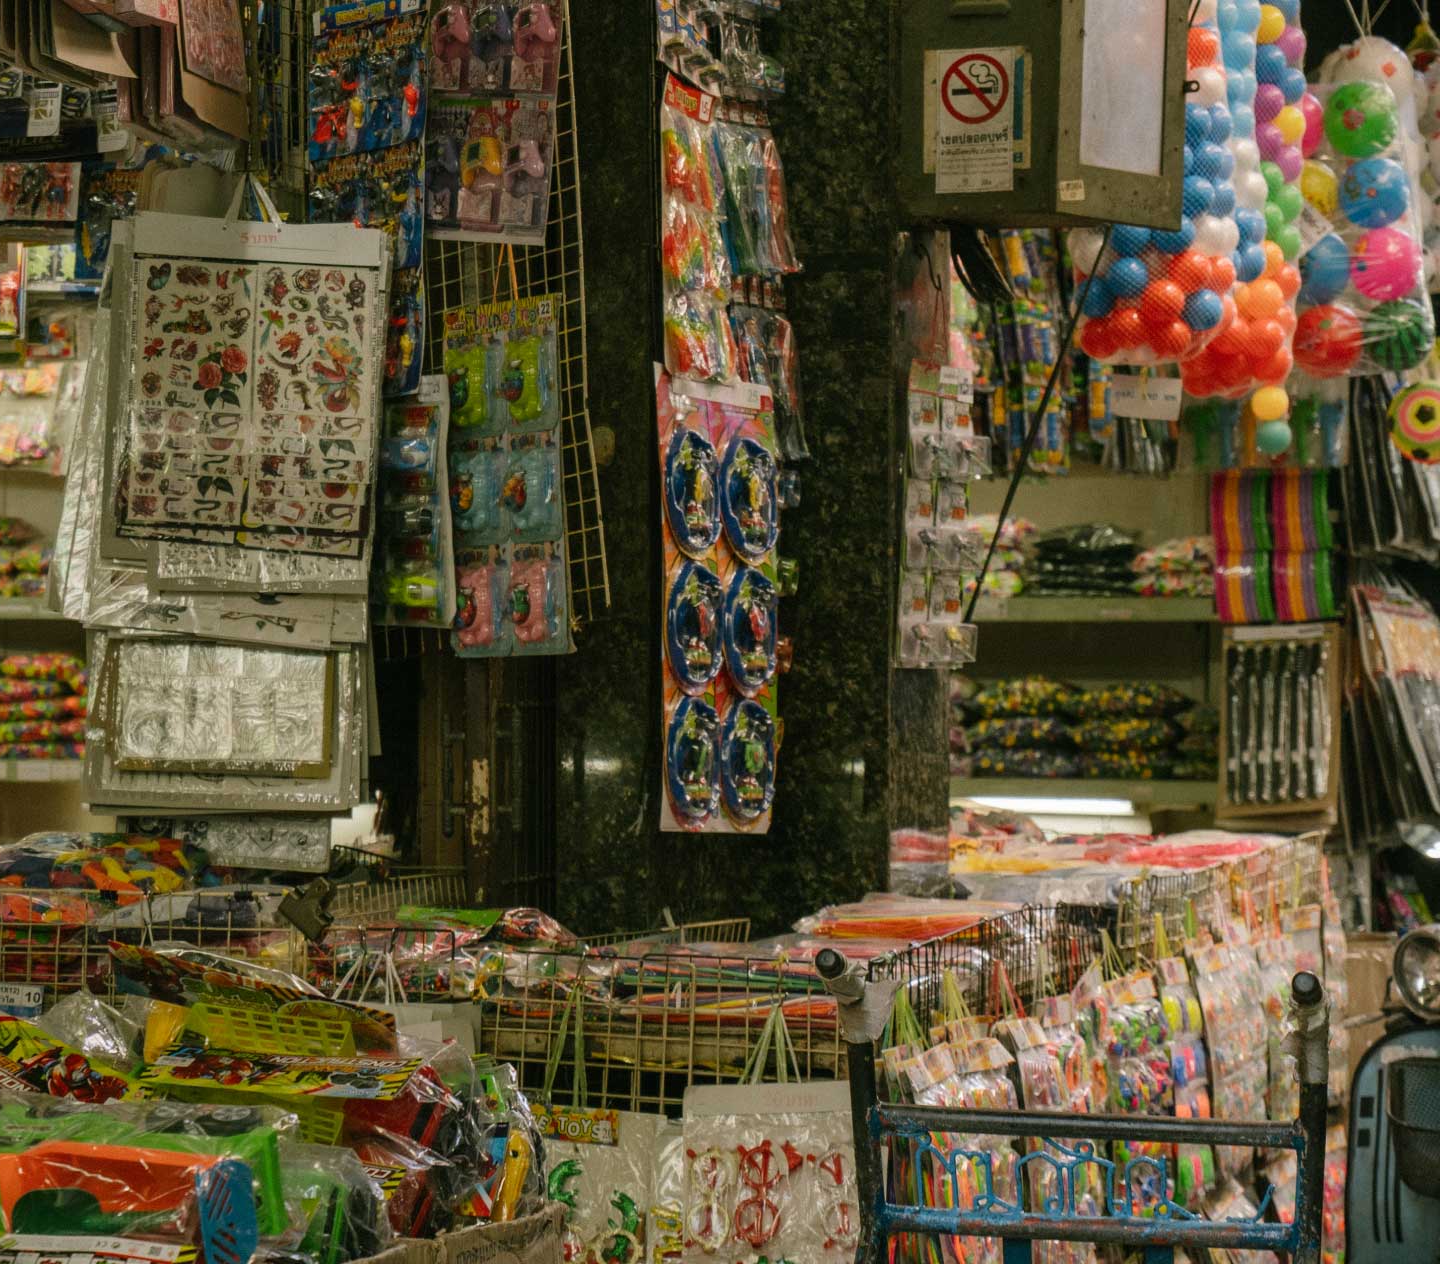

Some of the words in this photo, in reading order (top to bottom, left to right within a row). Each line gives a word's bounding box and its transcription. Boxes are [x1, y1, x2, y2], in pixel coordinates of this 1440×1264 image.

[541, 302, 551, 315] 22
[25, 991, 42, 1004] 10
[559, 1116, 603, 1139] TOYS
